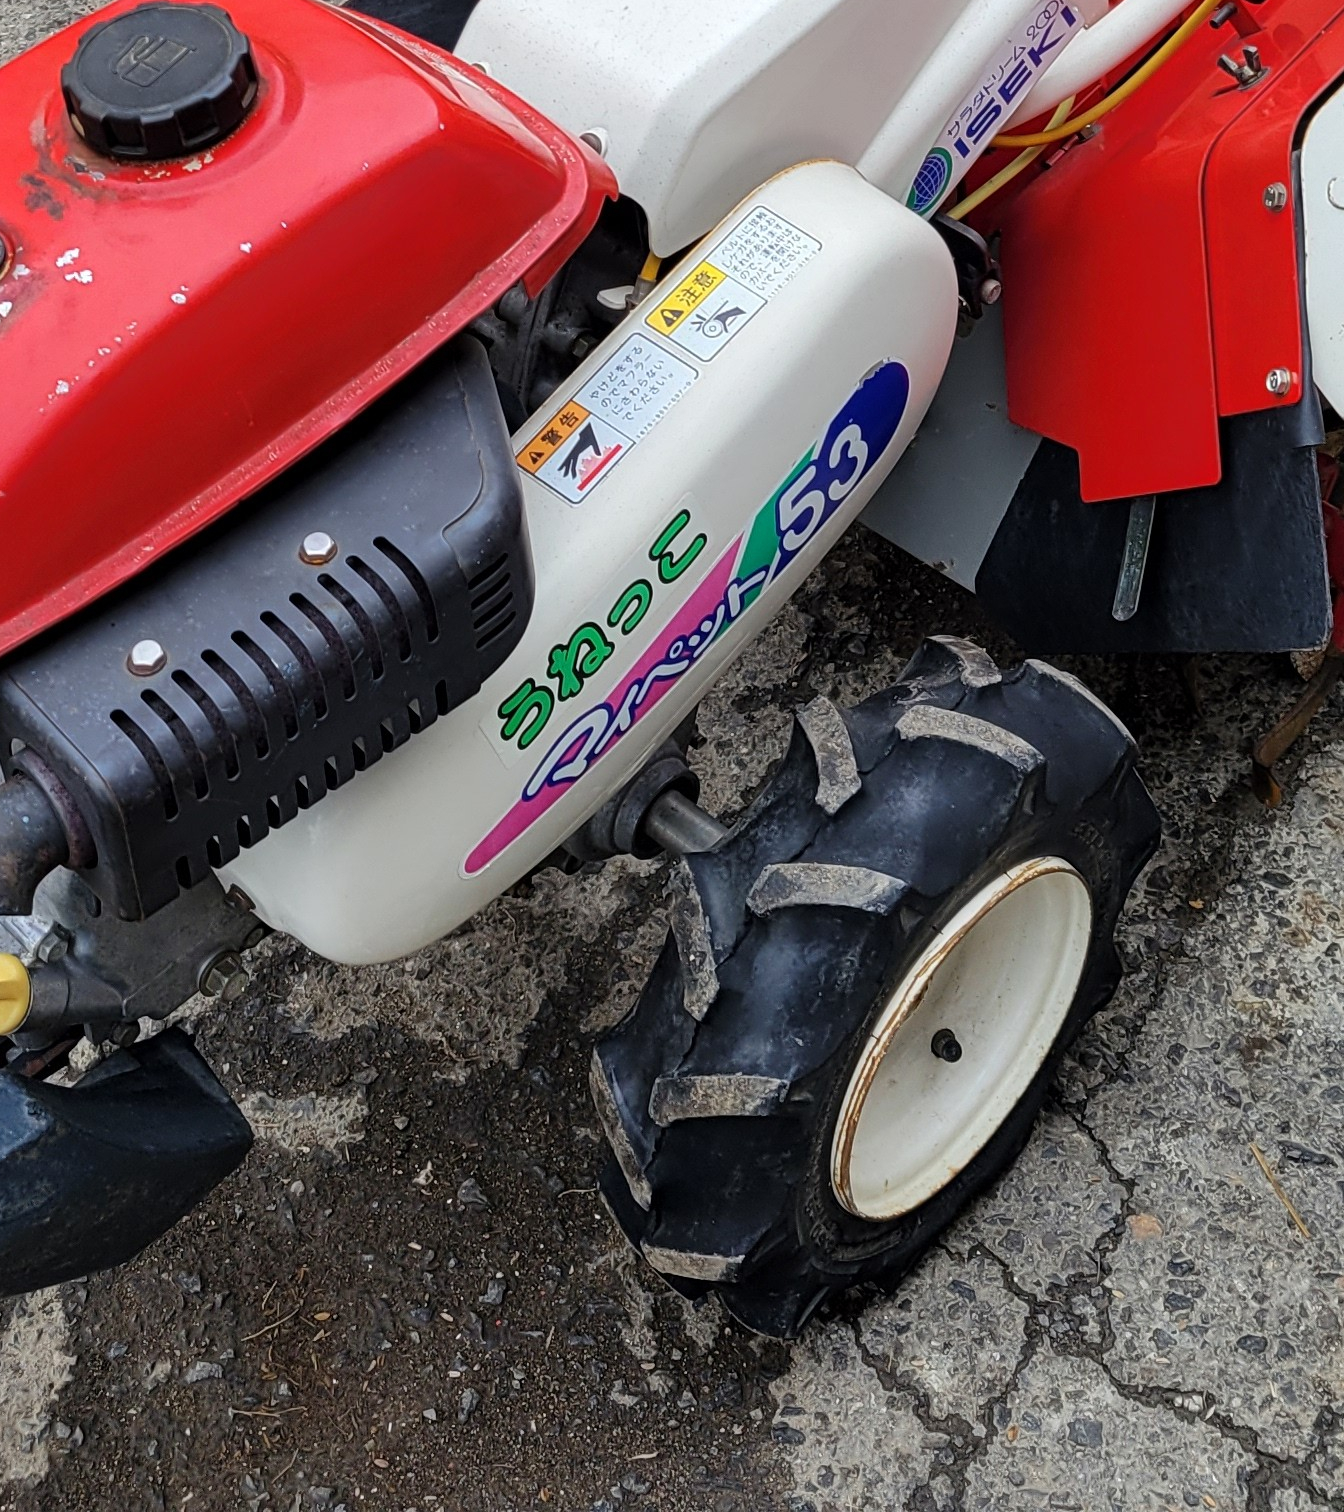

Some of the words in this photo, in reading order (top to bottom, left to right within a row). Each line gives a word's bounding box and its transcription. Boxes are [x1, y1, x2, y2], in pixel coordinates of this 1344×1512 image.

[947, 46, 1026, 138] サラダドリーム
[954, 6, 1076, 158] ISEKI
[676, 271, 716, 306] 注意
[589, 347, 642, 398] やけどをする
[601, 355, 651, 407] のでマフラー
[612, 361, 664, 415] にさわらない
[622, 374, 673, 420] でください。
[541, 412, 579, 446] 警告
[498, 509, 707, 750] うねっこ
[522, 567, 769, 800] マイペット
[776, 424, 868, 552] 53
